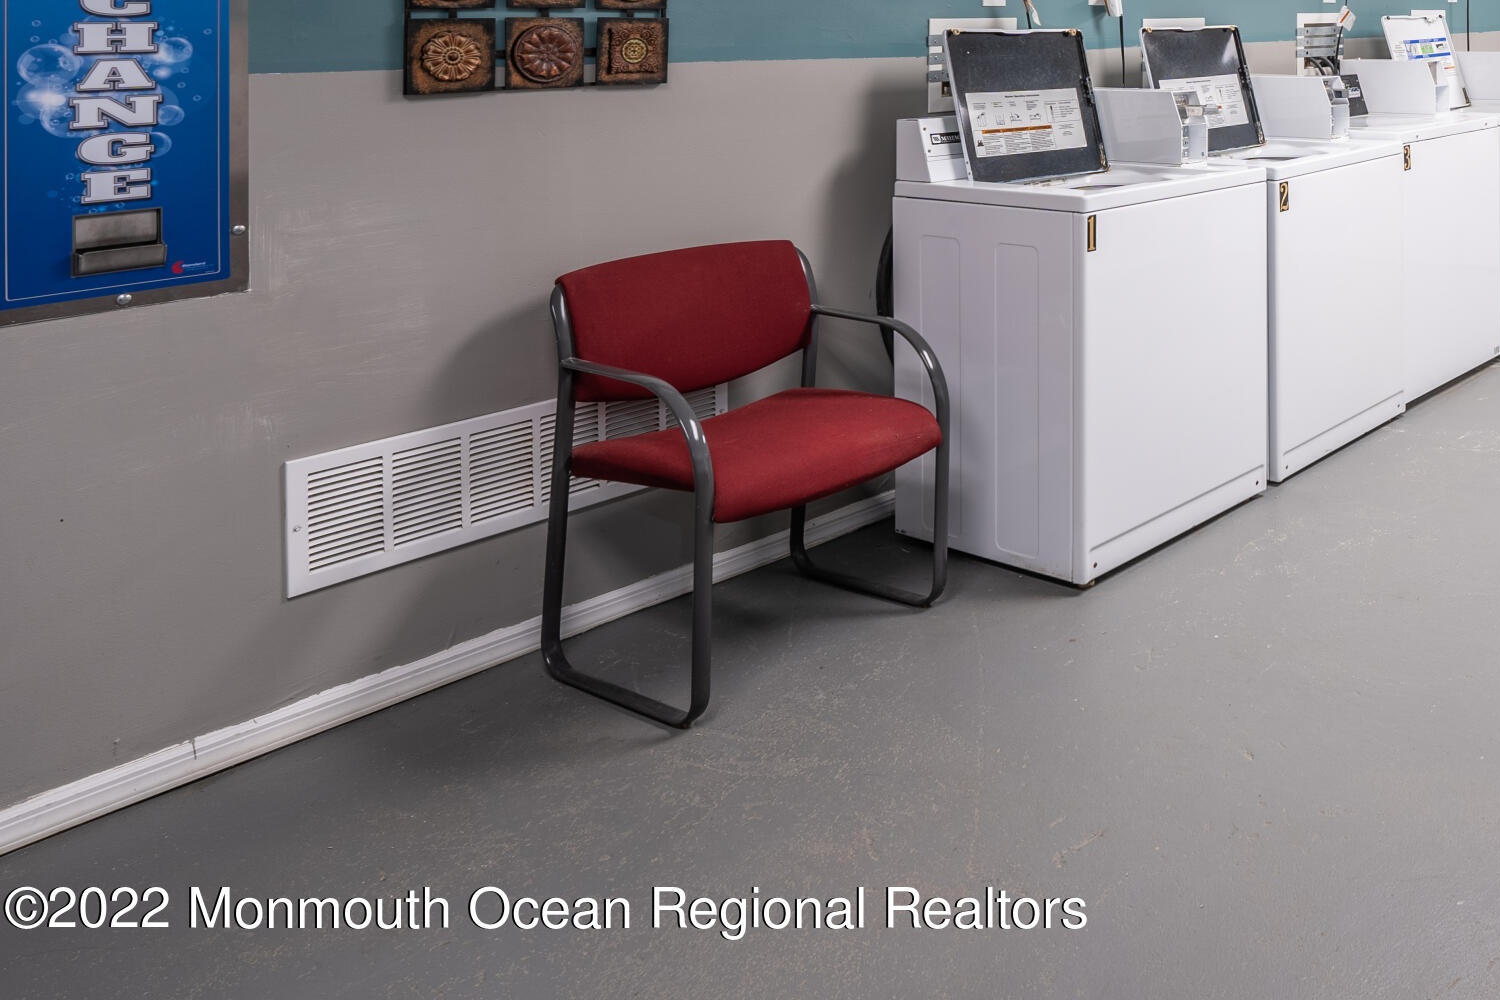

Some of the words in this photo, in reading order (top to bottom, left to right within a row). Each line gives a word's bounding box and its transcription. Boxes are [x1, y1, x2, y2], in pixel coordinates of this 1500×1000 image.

[1404, 145, 1410, 170] 3
[1280, 182, 1288, 211] 2
[1088, 216, 1096, 250] 1
